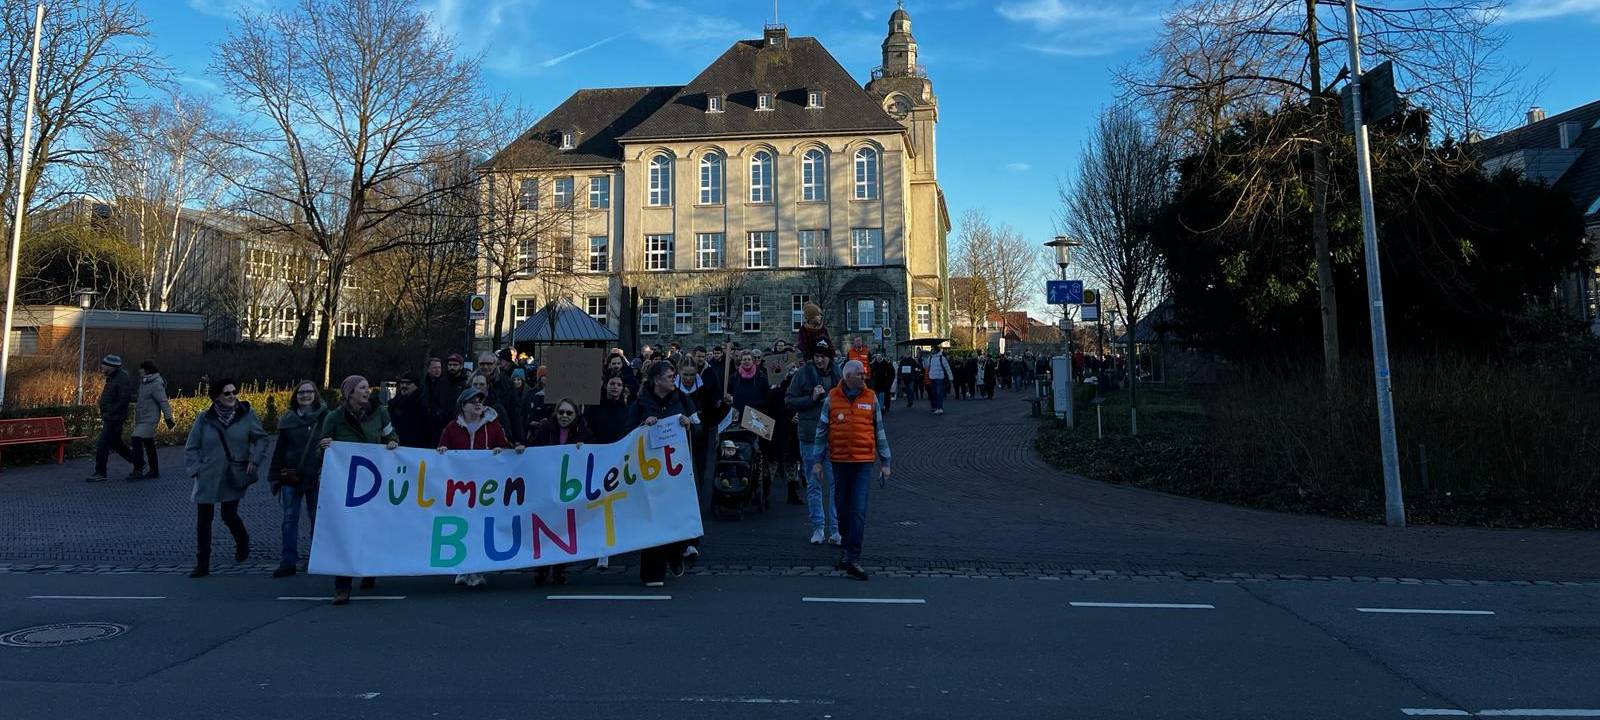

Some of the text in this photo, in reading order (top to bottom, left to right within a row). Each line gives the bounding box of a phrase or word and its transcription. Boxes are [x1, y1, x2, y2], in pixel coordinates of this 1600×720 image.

[345, 432, 683, 508] Dülmen bleibt
[430, 491, 628, 568] BUNT
